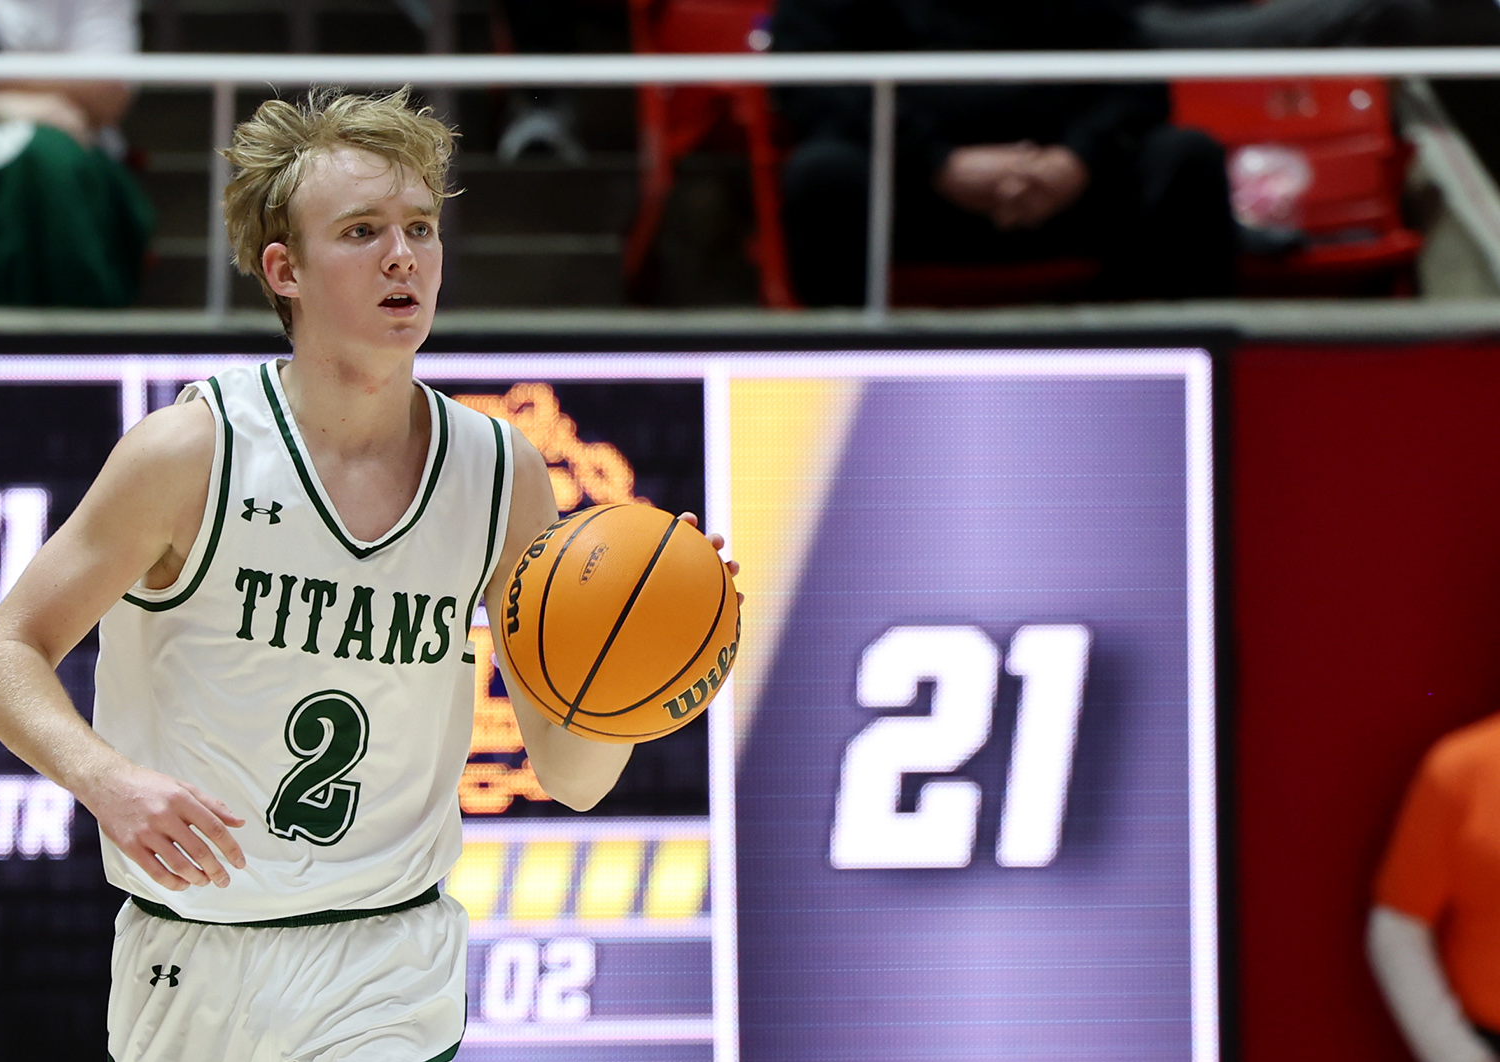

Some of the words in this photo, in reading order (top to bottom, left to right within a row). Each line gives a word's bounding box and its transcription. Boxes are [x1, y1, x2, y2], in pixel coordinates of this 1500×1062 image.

[234, 566, 457, 665] TITANS
[266, 689, 370, 847] 2
[830, 624, 1093, 869] 21
[481, 935, 597, 1024] 02
